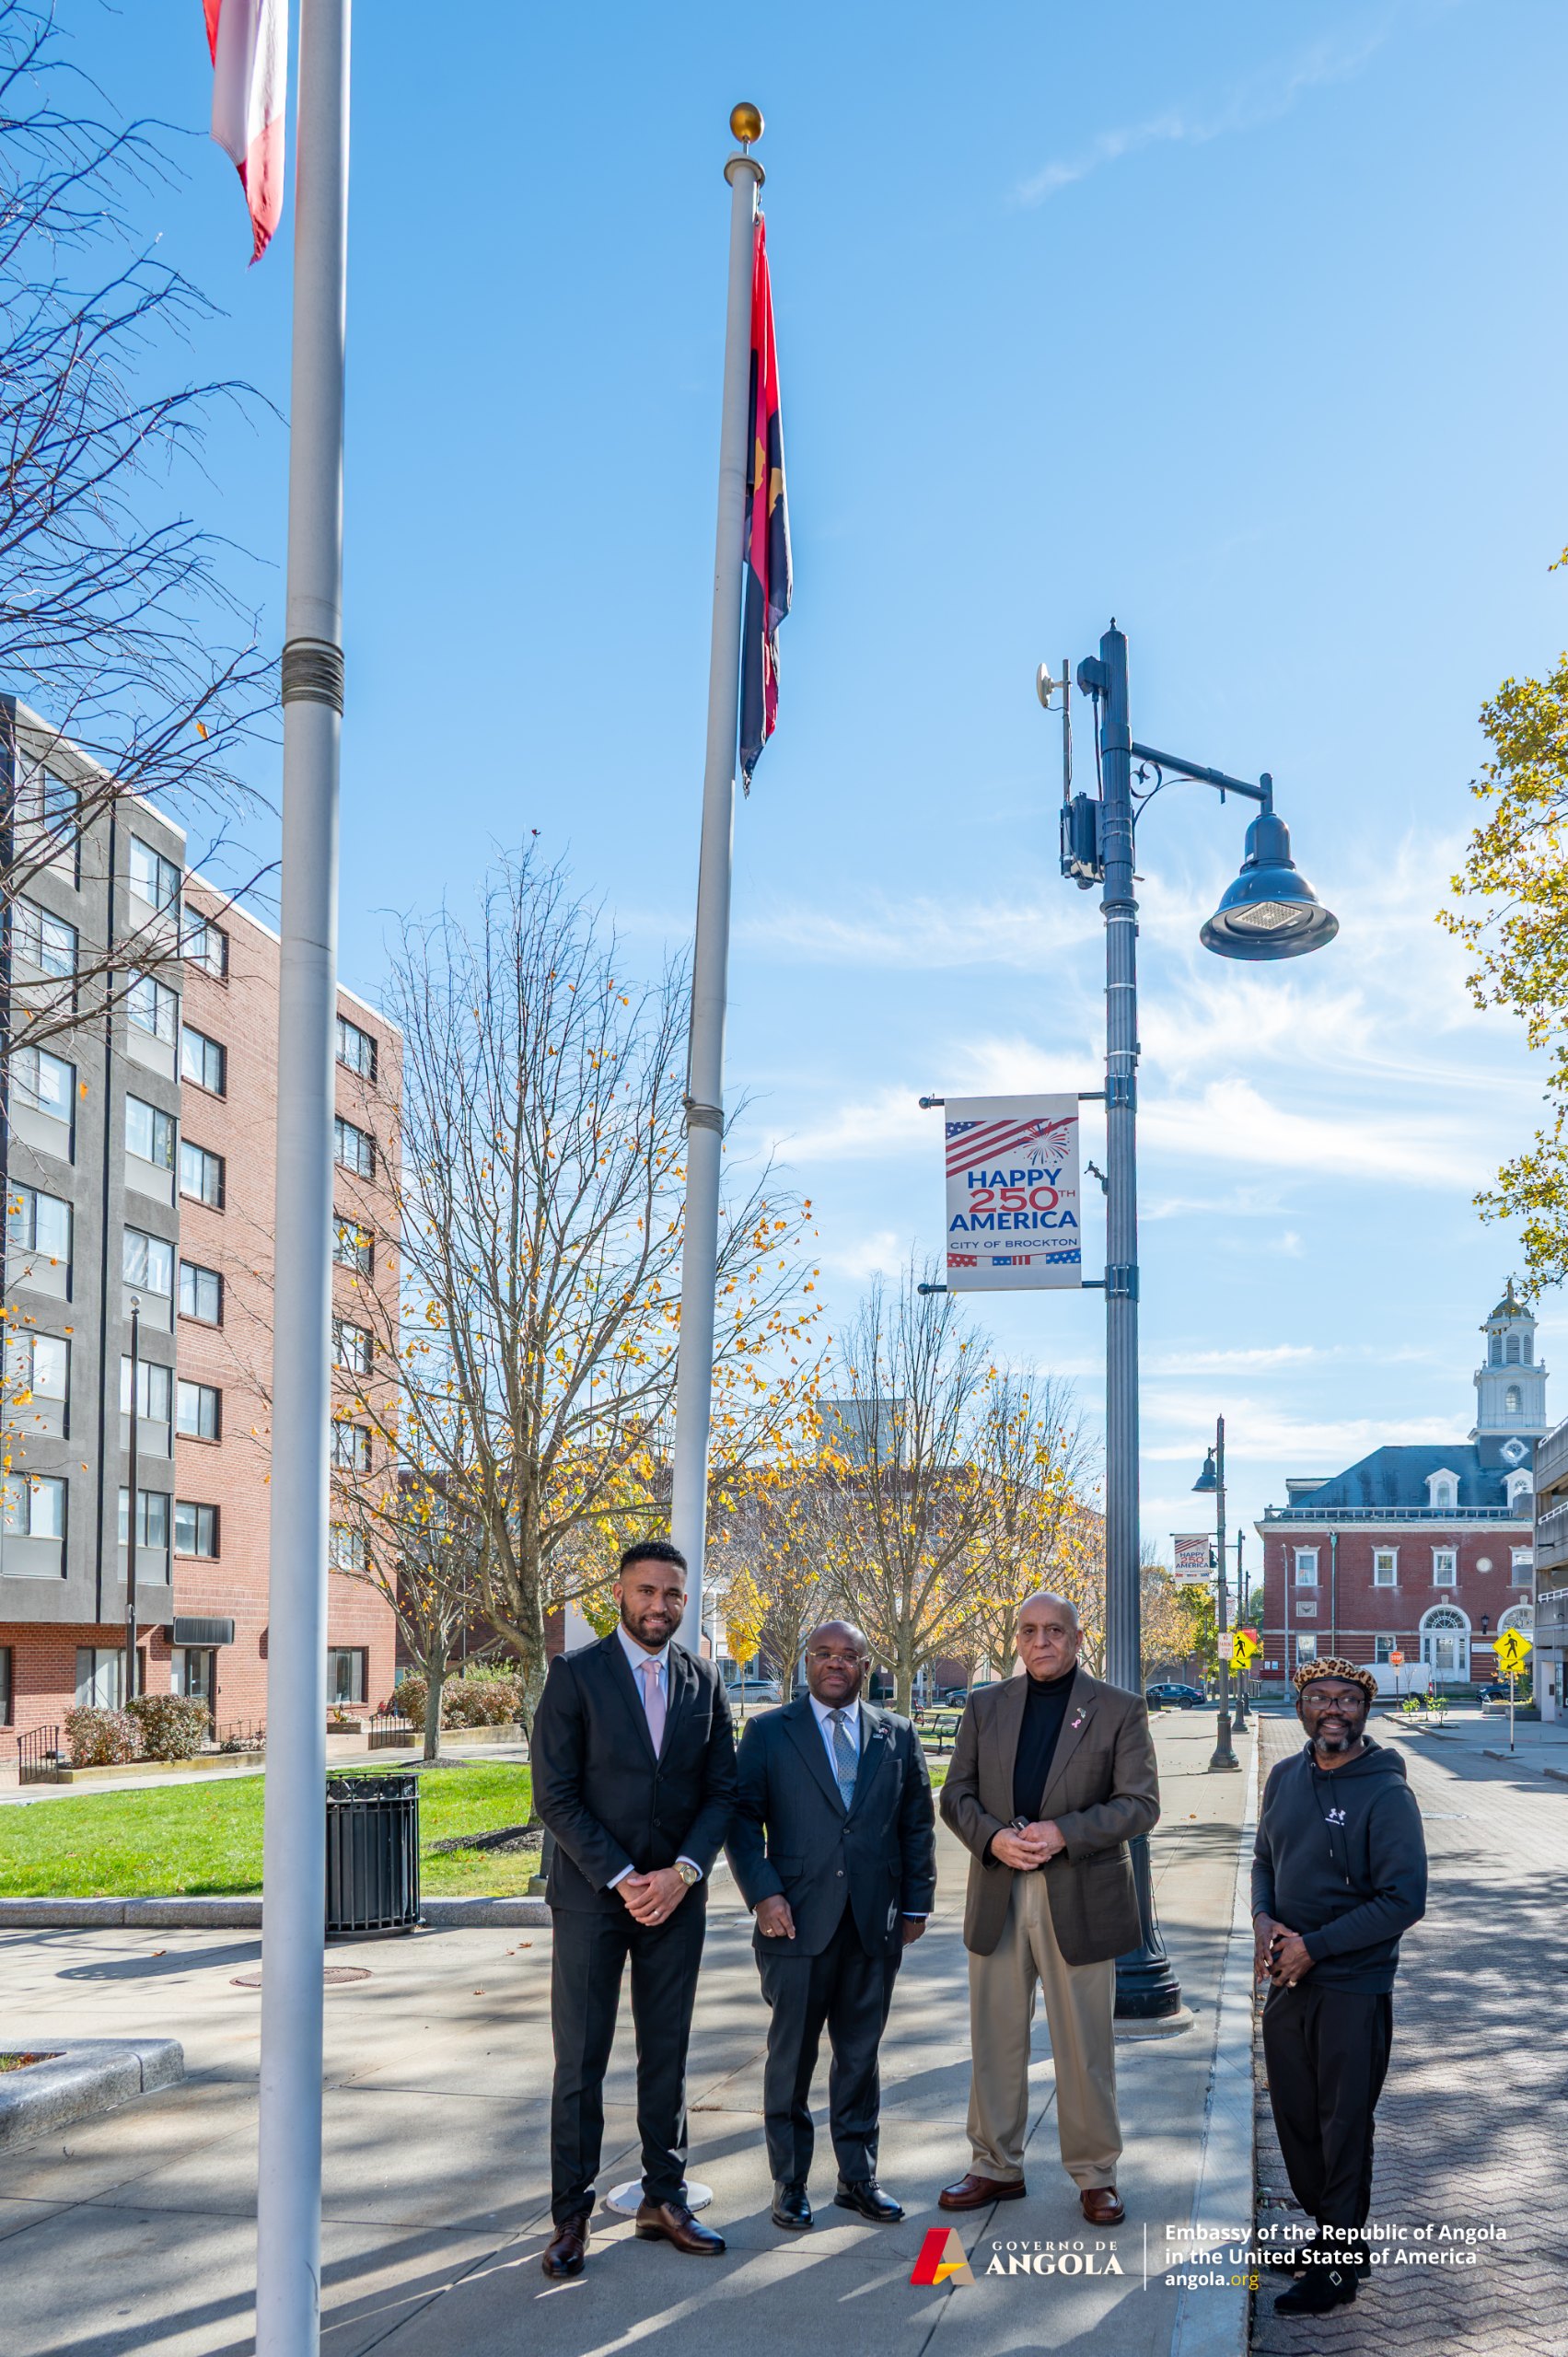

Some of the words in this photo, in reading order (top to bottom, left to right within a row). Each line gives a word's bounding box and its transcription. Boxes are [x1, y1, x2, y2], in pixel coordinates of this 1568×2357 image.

[968, 1168, 1063, 1189] HAPPY
[949, 1211, 1078, 1232] AMERICA
[950, 1241, 980, 1249] CITY
[983, 1240, 1000, 1248] OF
[1005, 1238, 1078, 1248] BROCKTON
